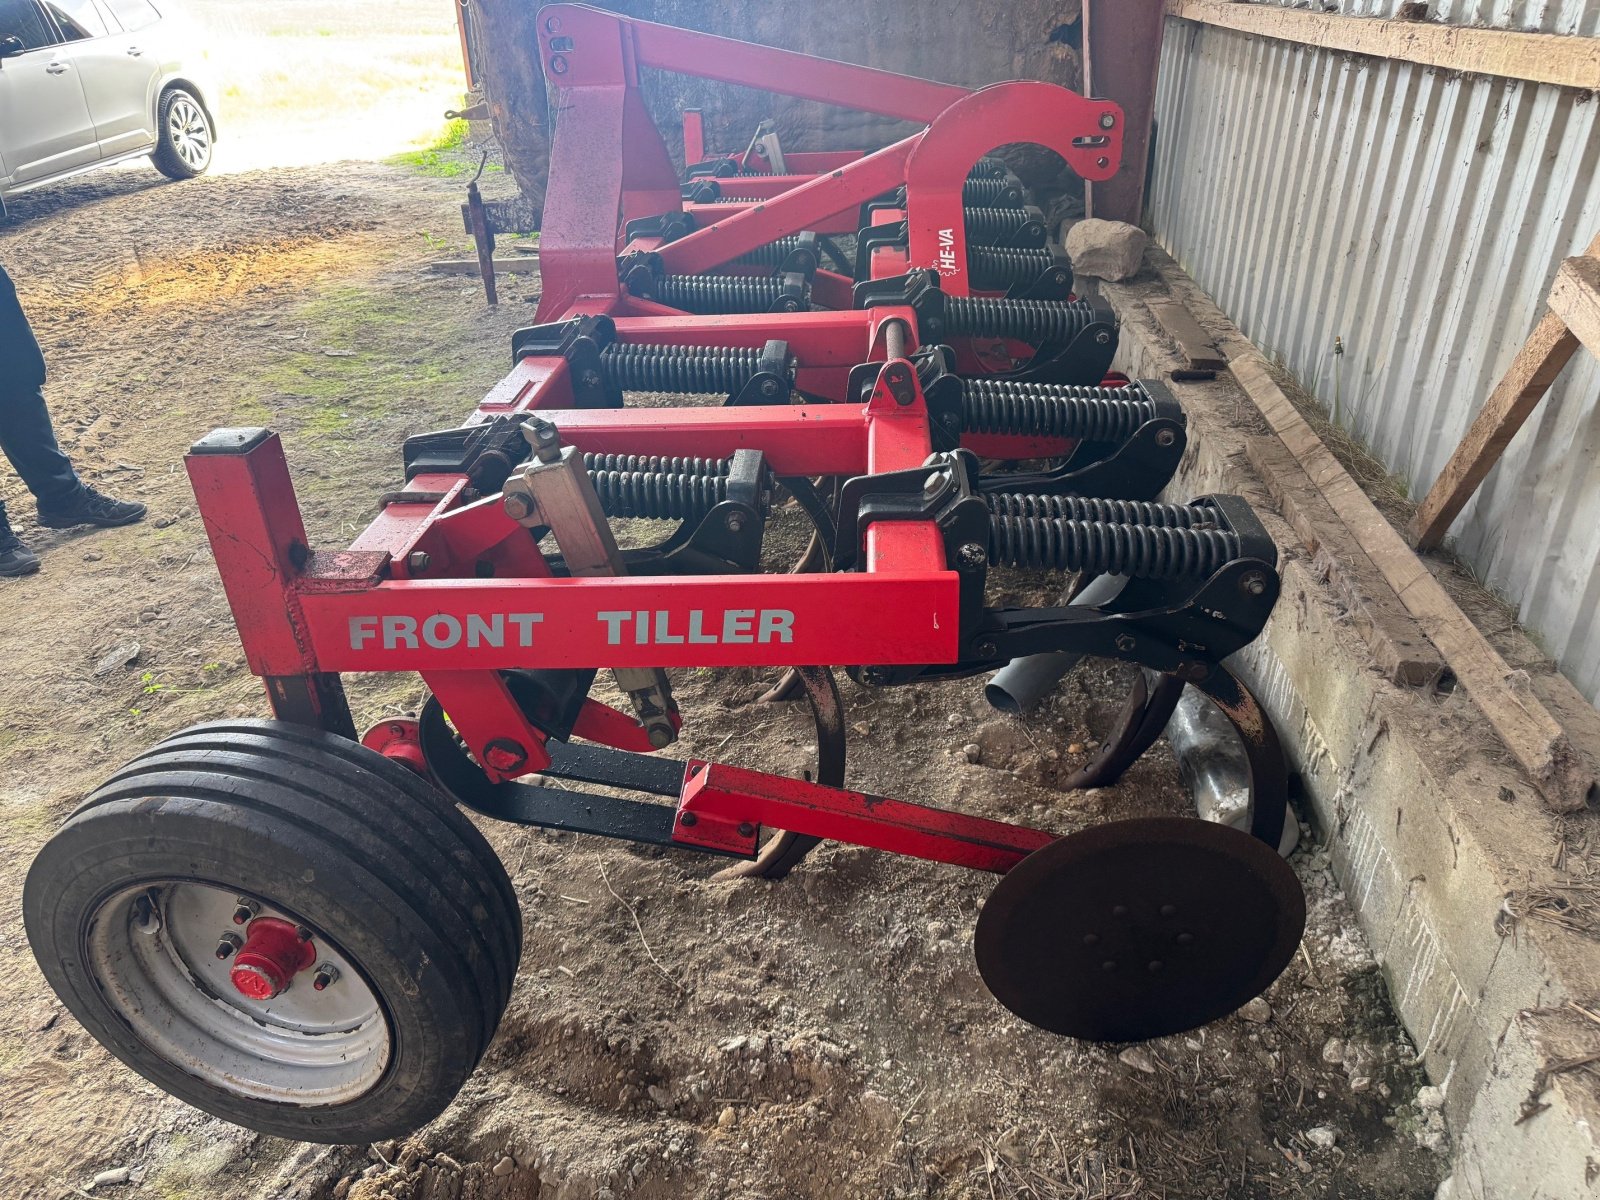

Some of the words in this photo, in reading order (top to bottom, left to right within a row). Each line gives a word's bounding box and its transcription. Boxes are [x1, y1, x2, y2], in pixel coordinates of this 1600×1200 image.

[939, 228, 956, 269] HE-VA
[348, 612, 543, 649] FRONT
[597, 609, 794, 645] TILLER
